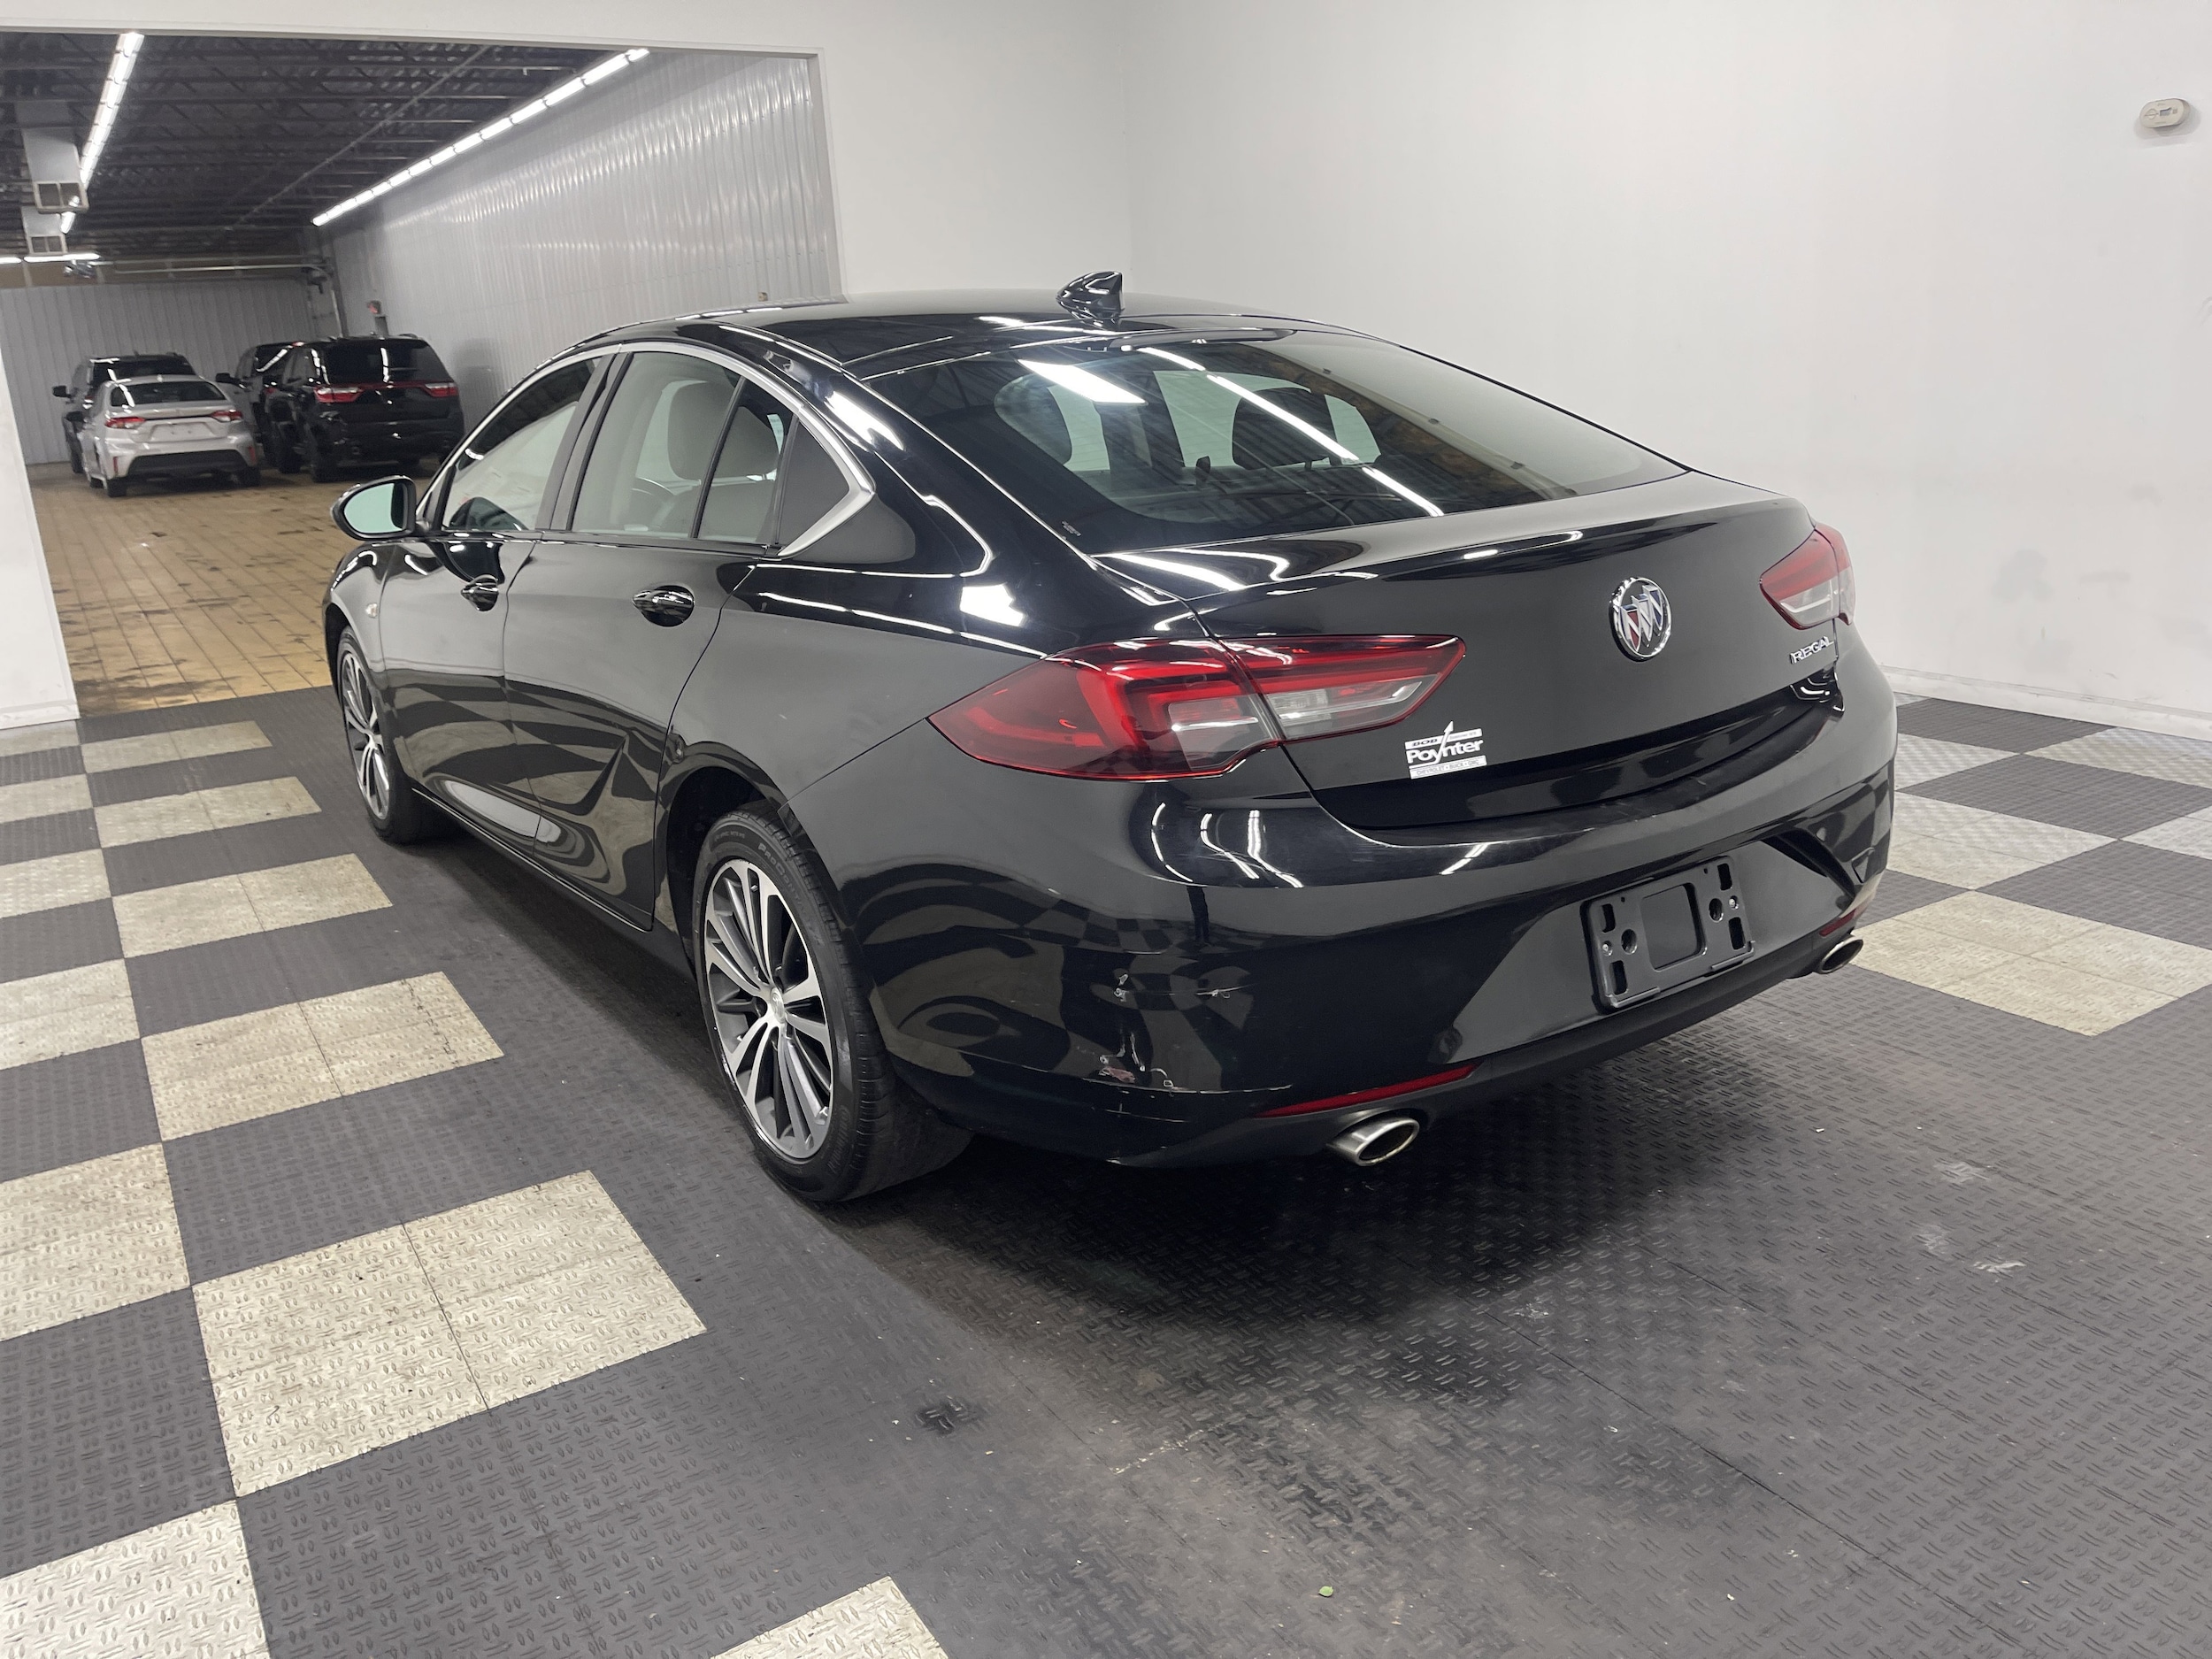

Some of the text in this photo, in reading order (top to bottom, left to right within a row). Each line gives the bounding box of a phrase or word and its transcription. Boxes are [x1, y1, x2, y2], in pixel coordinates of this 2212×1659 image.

[1789, 635, 1834, 664] REGAL
[1405, 739, 1484, 765] Poynter
[1412, 738, 1438, 747] BOB
